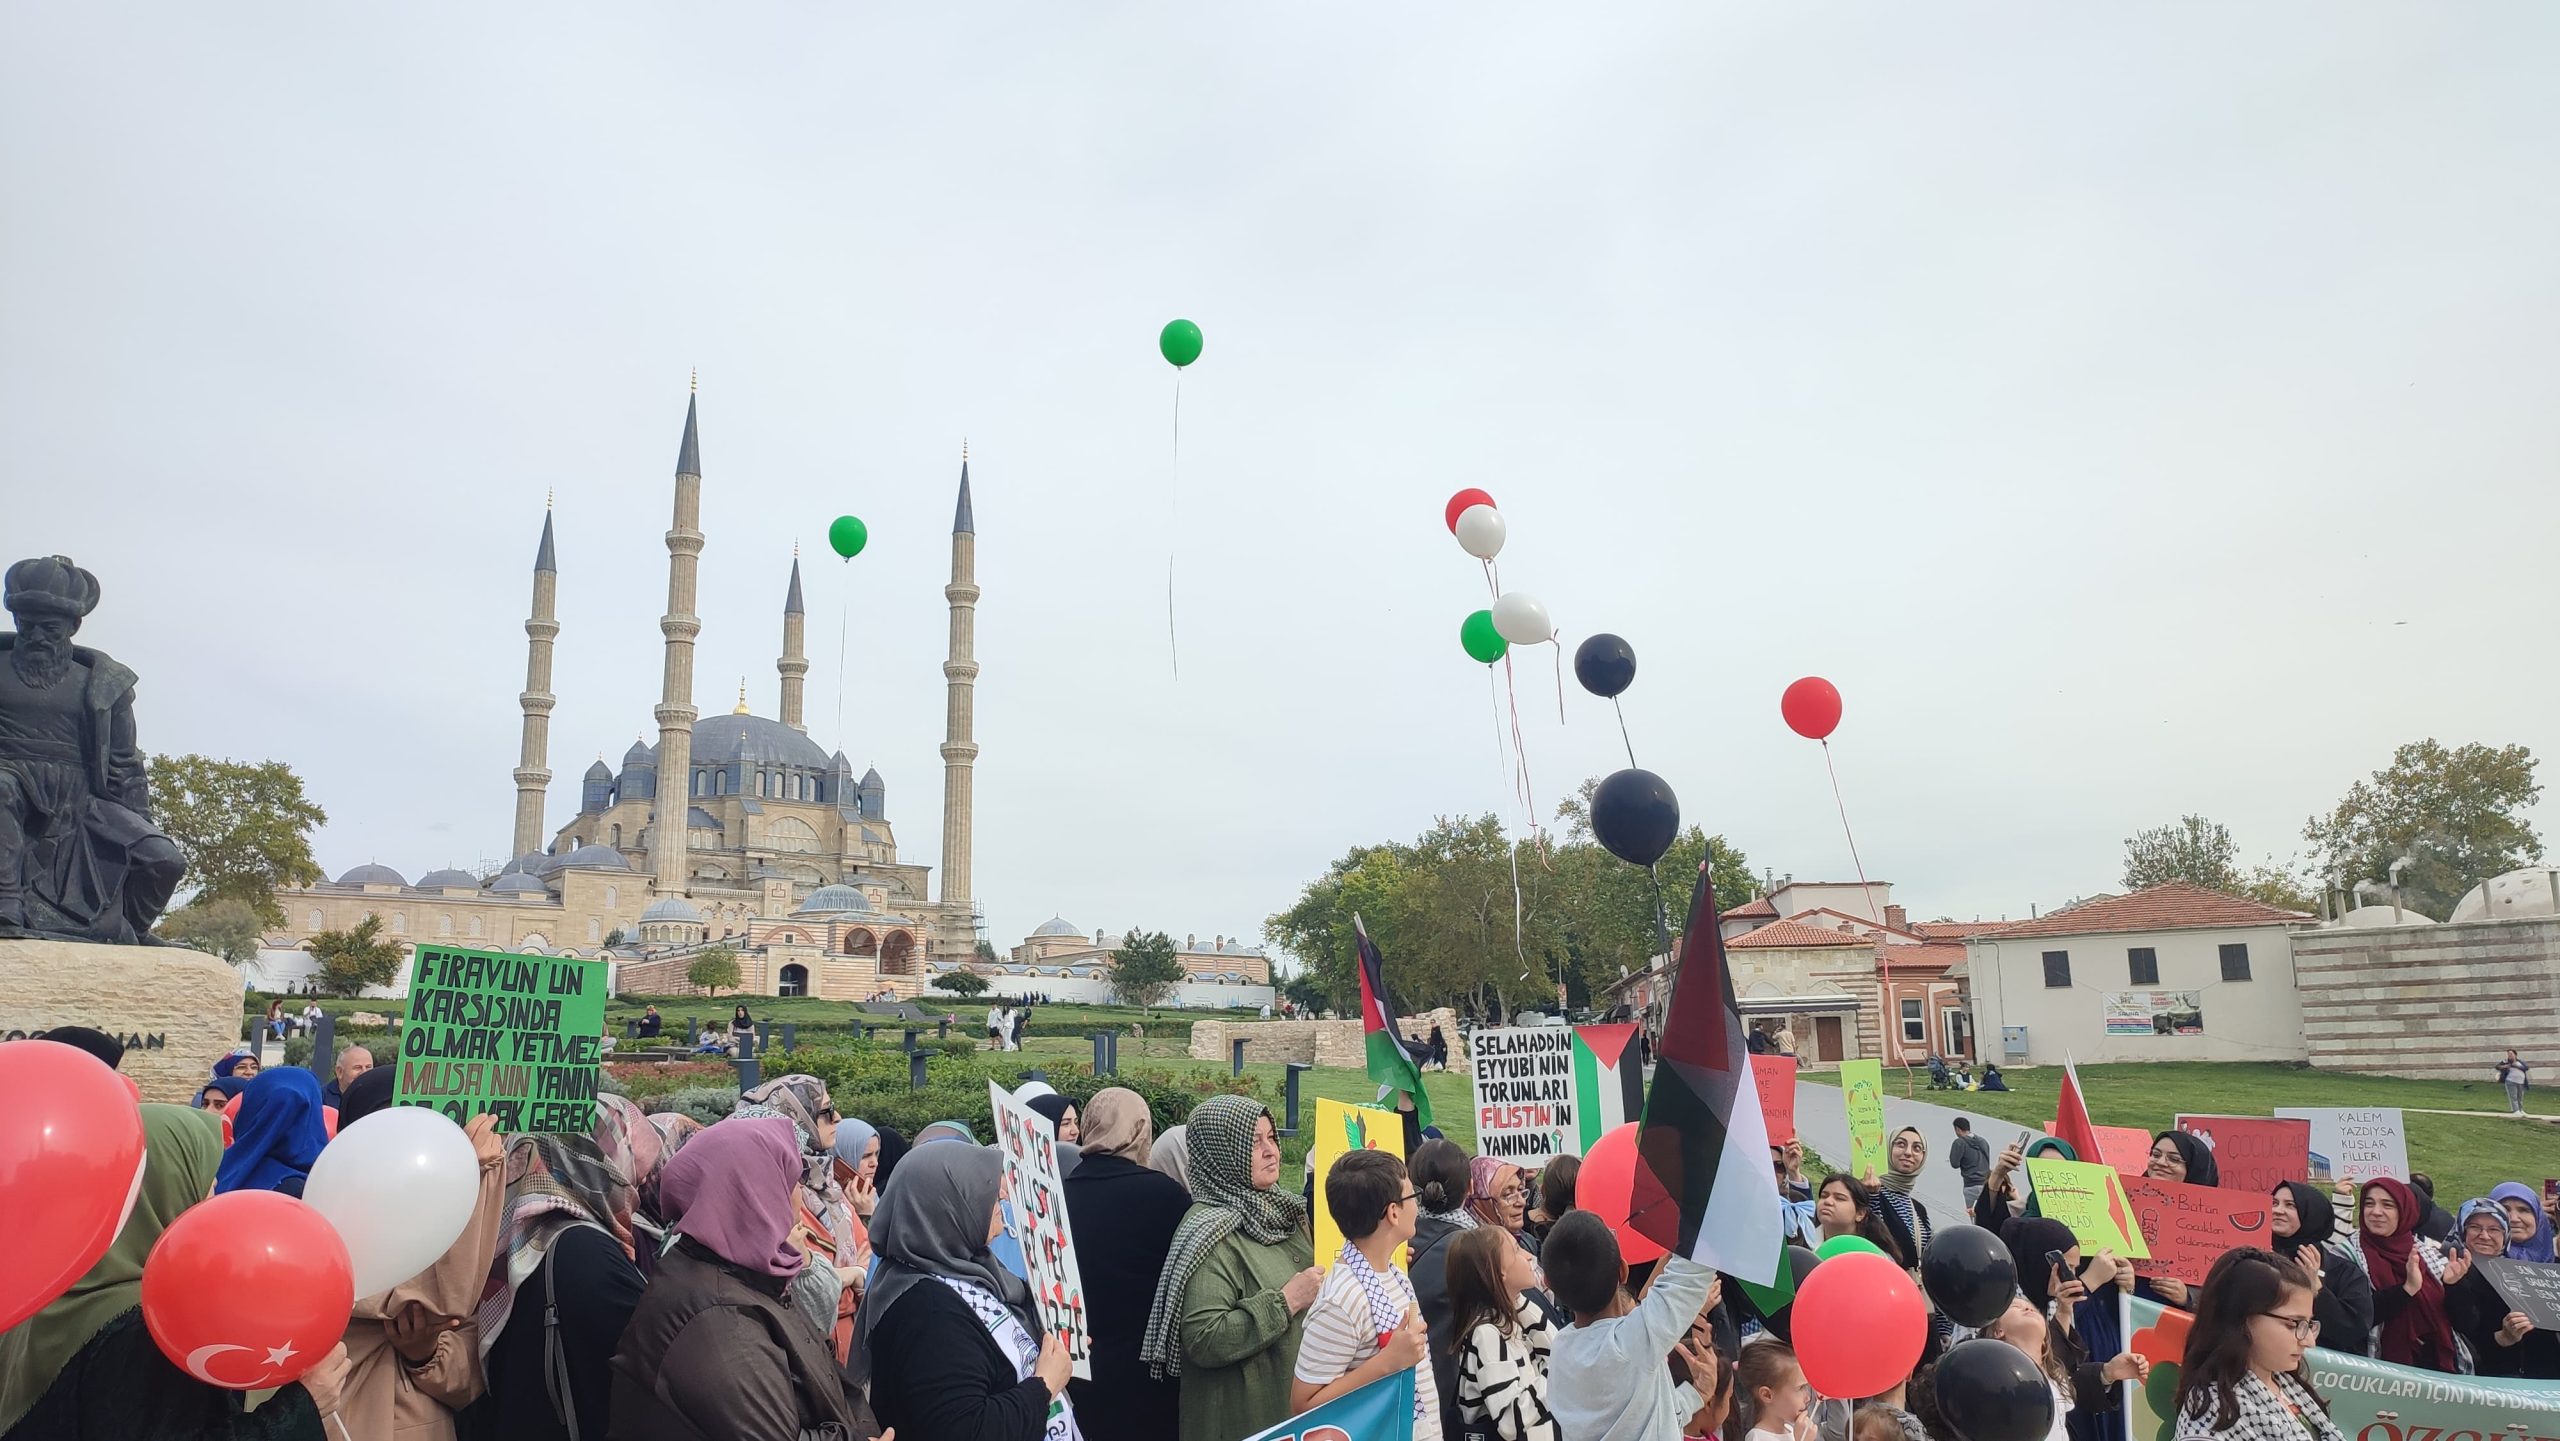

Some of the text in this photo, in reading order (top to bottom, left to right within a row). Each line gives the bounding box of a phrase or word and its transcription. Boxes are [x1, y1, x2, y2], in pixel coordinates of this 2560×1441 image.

[417, 951, 584, 995] FİRAVUN'UN
[404, 1026, 600, 1065] OLMAK YETMEZ
[1475, 1029, 1572, 1056] SELAHADDİN
[401, 1062, 600, 1100] MUSA'NIN YANIN
[1477, 1053, 1569, 1080] EYYUBİ'NİN
[1478, 1079, 1568, 1104] TORUNLARI
[528, 1102, 597, 1133] GEREK
[1481, 1103, 1571, 1129] FİLİSTİN'İN
[2338, 1112, 2382, 1122] KALEM
[998, 1100, 1054, 1180] HER YER
[1482, 1132, 1551, 1157] YANINDA
[2034, 1170, 2056, 1184] HER
[1040, 1228, 1067, 1283] YER
[1035, 1276, 1087, 1361] AZZE
[2312, 1370, 2422, 1400] ÇOCUKLARI
[2470, 1387, 2560, 1414] MEYDANL
